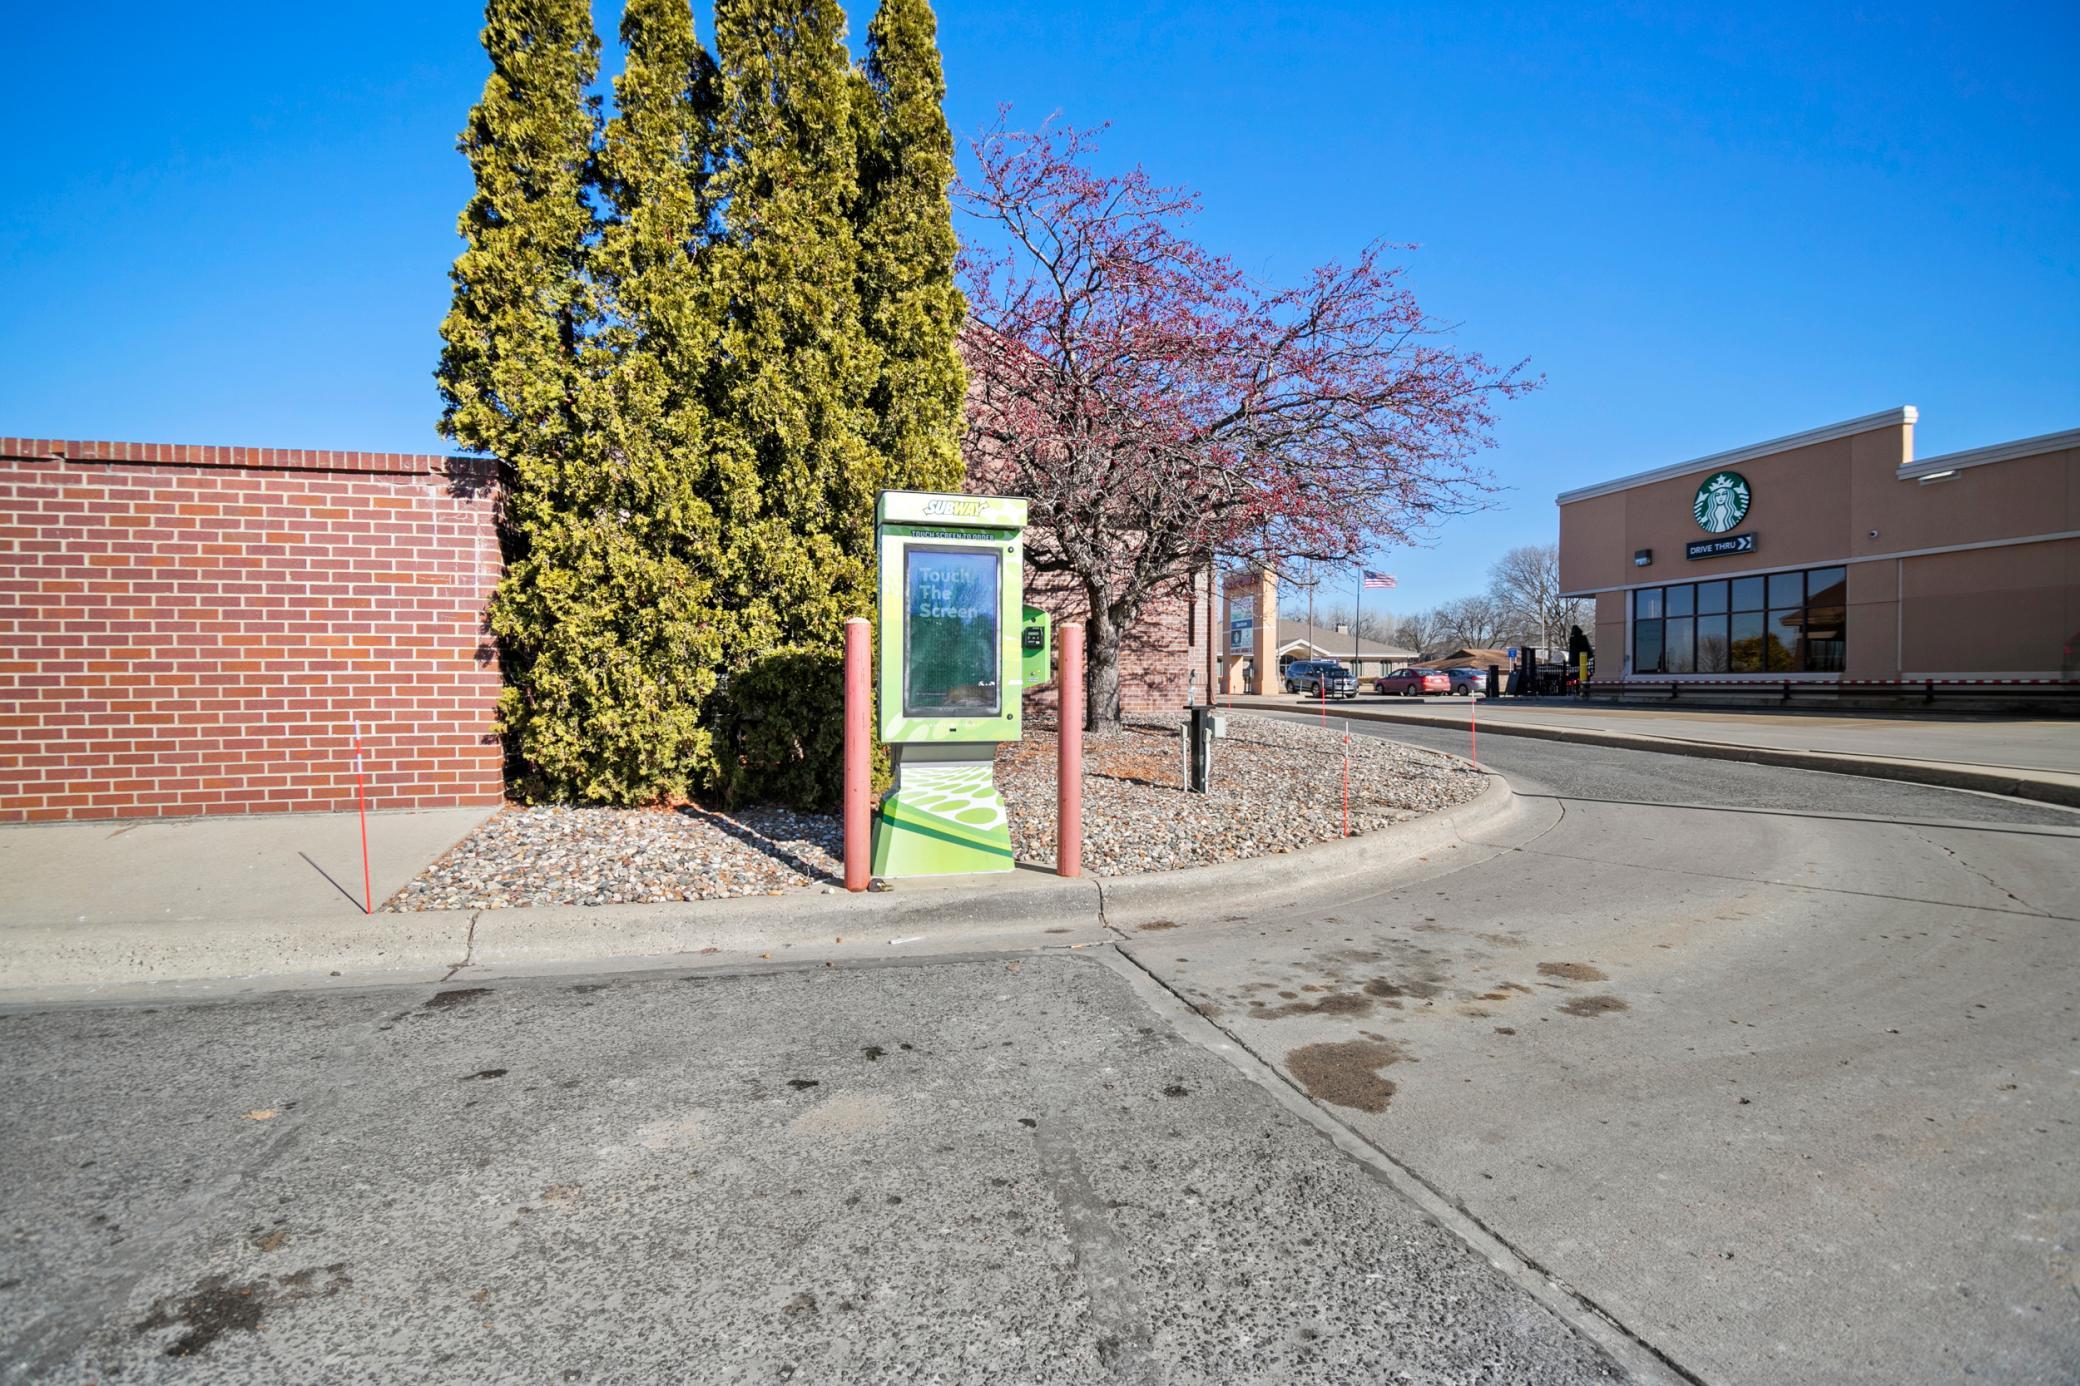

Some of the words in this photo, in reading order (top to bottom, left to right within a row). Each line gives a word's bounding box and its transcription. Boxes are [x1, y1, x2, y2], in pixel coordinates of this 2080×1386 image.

[923, 500, 989, 516] SUBWAY
[911, 530, 934, 538] TOUCH
[935, 532, 961, 540] SCREEN
[1690, 544, 1713, 554] DRIVE
[1715, 541, 1736, 551] THRU
[919, 567, 970, 582] Touch
[919, 584, 952, 600] The
[919, 602, 978, 619] Screen
